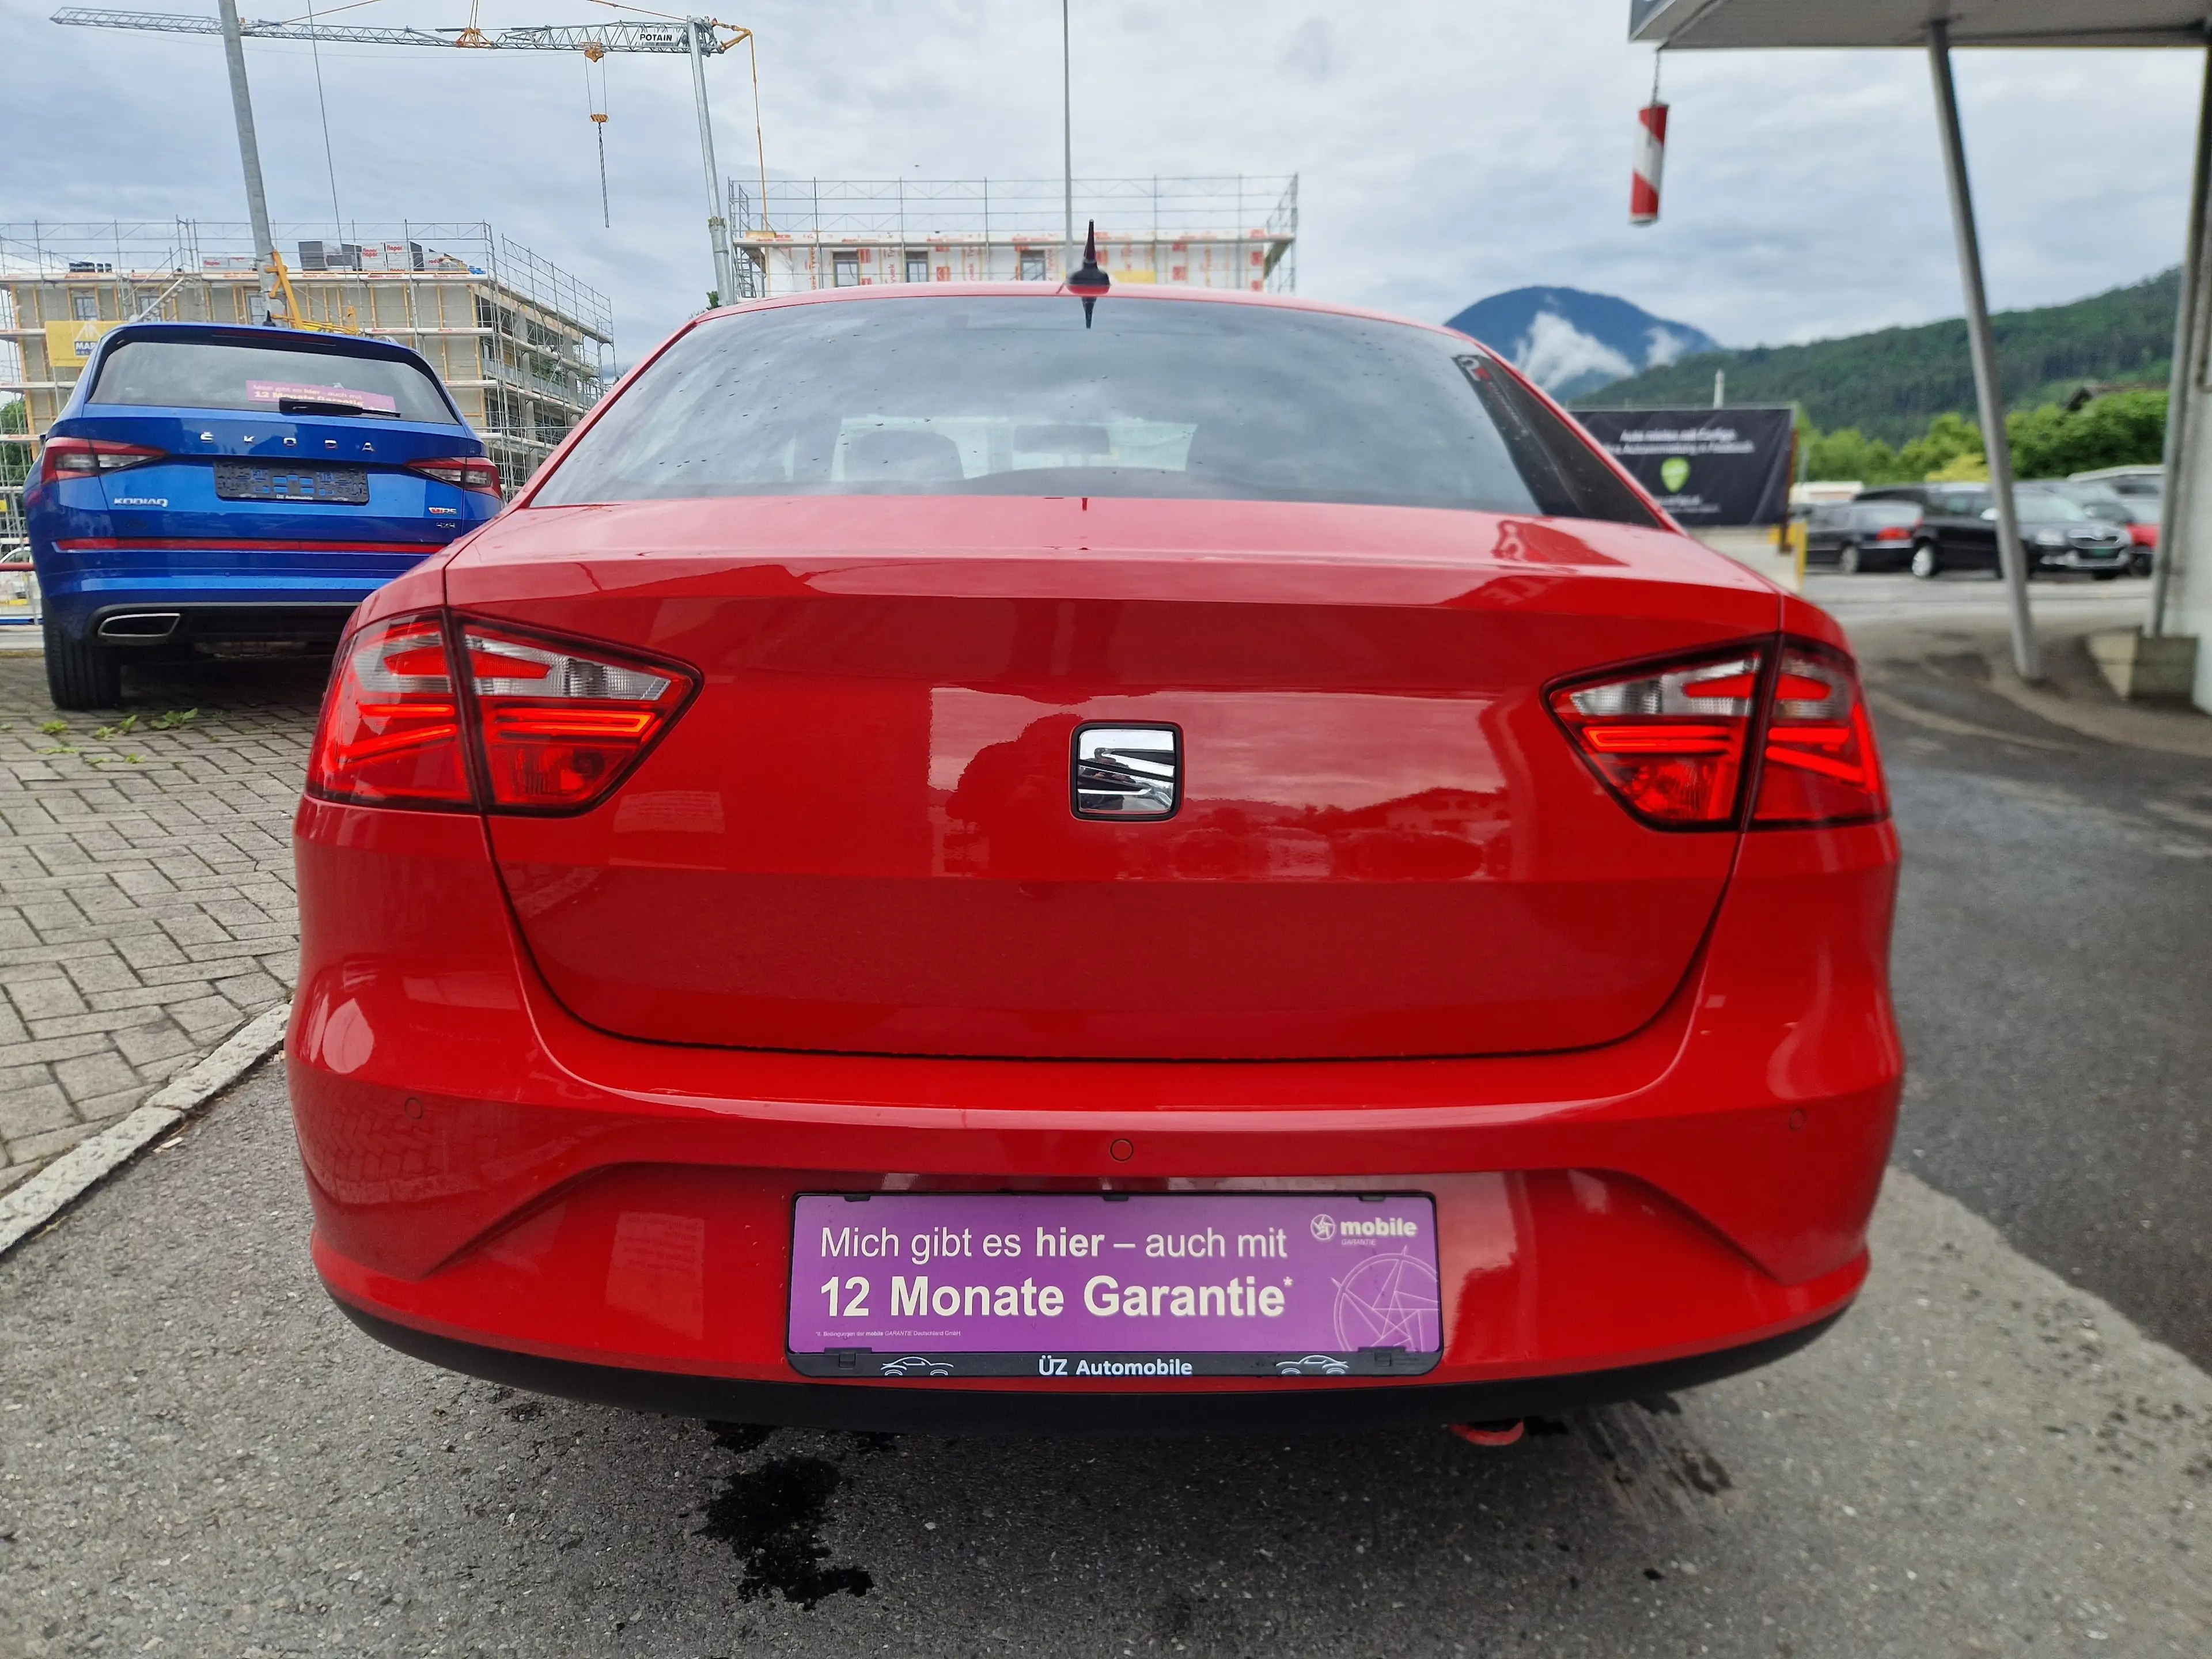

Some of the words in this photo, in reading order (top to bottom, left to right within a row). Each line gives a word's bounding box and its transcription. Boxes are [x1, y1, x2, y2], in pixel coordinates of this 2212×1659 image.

[640, 33, 672, 41] POTAIN
[114, 498, 168, 507] KODIAQ
[1340, 1217, 1418, 1236] mobile
[821, 1226, 899, 1257] Mich
[911, 1226, 972, 1265] gibt
[982, 1233, 1022, 1257] es
[1036, 1226, 1105, 1257] hier
[1145, 1227, 1226, 1257] auch
[1237, 1227, 1288, 1258] mit
[821, 1276, 870, 1317] 12
[891, 1276, 1065, 1317] Monate
[1039, 1354, 1068, 1376] ÜZ
[1075, 1358, 1192, 1376] Automobile
